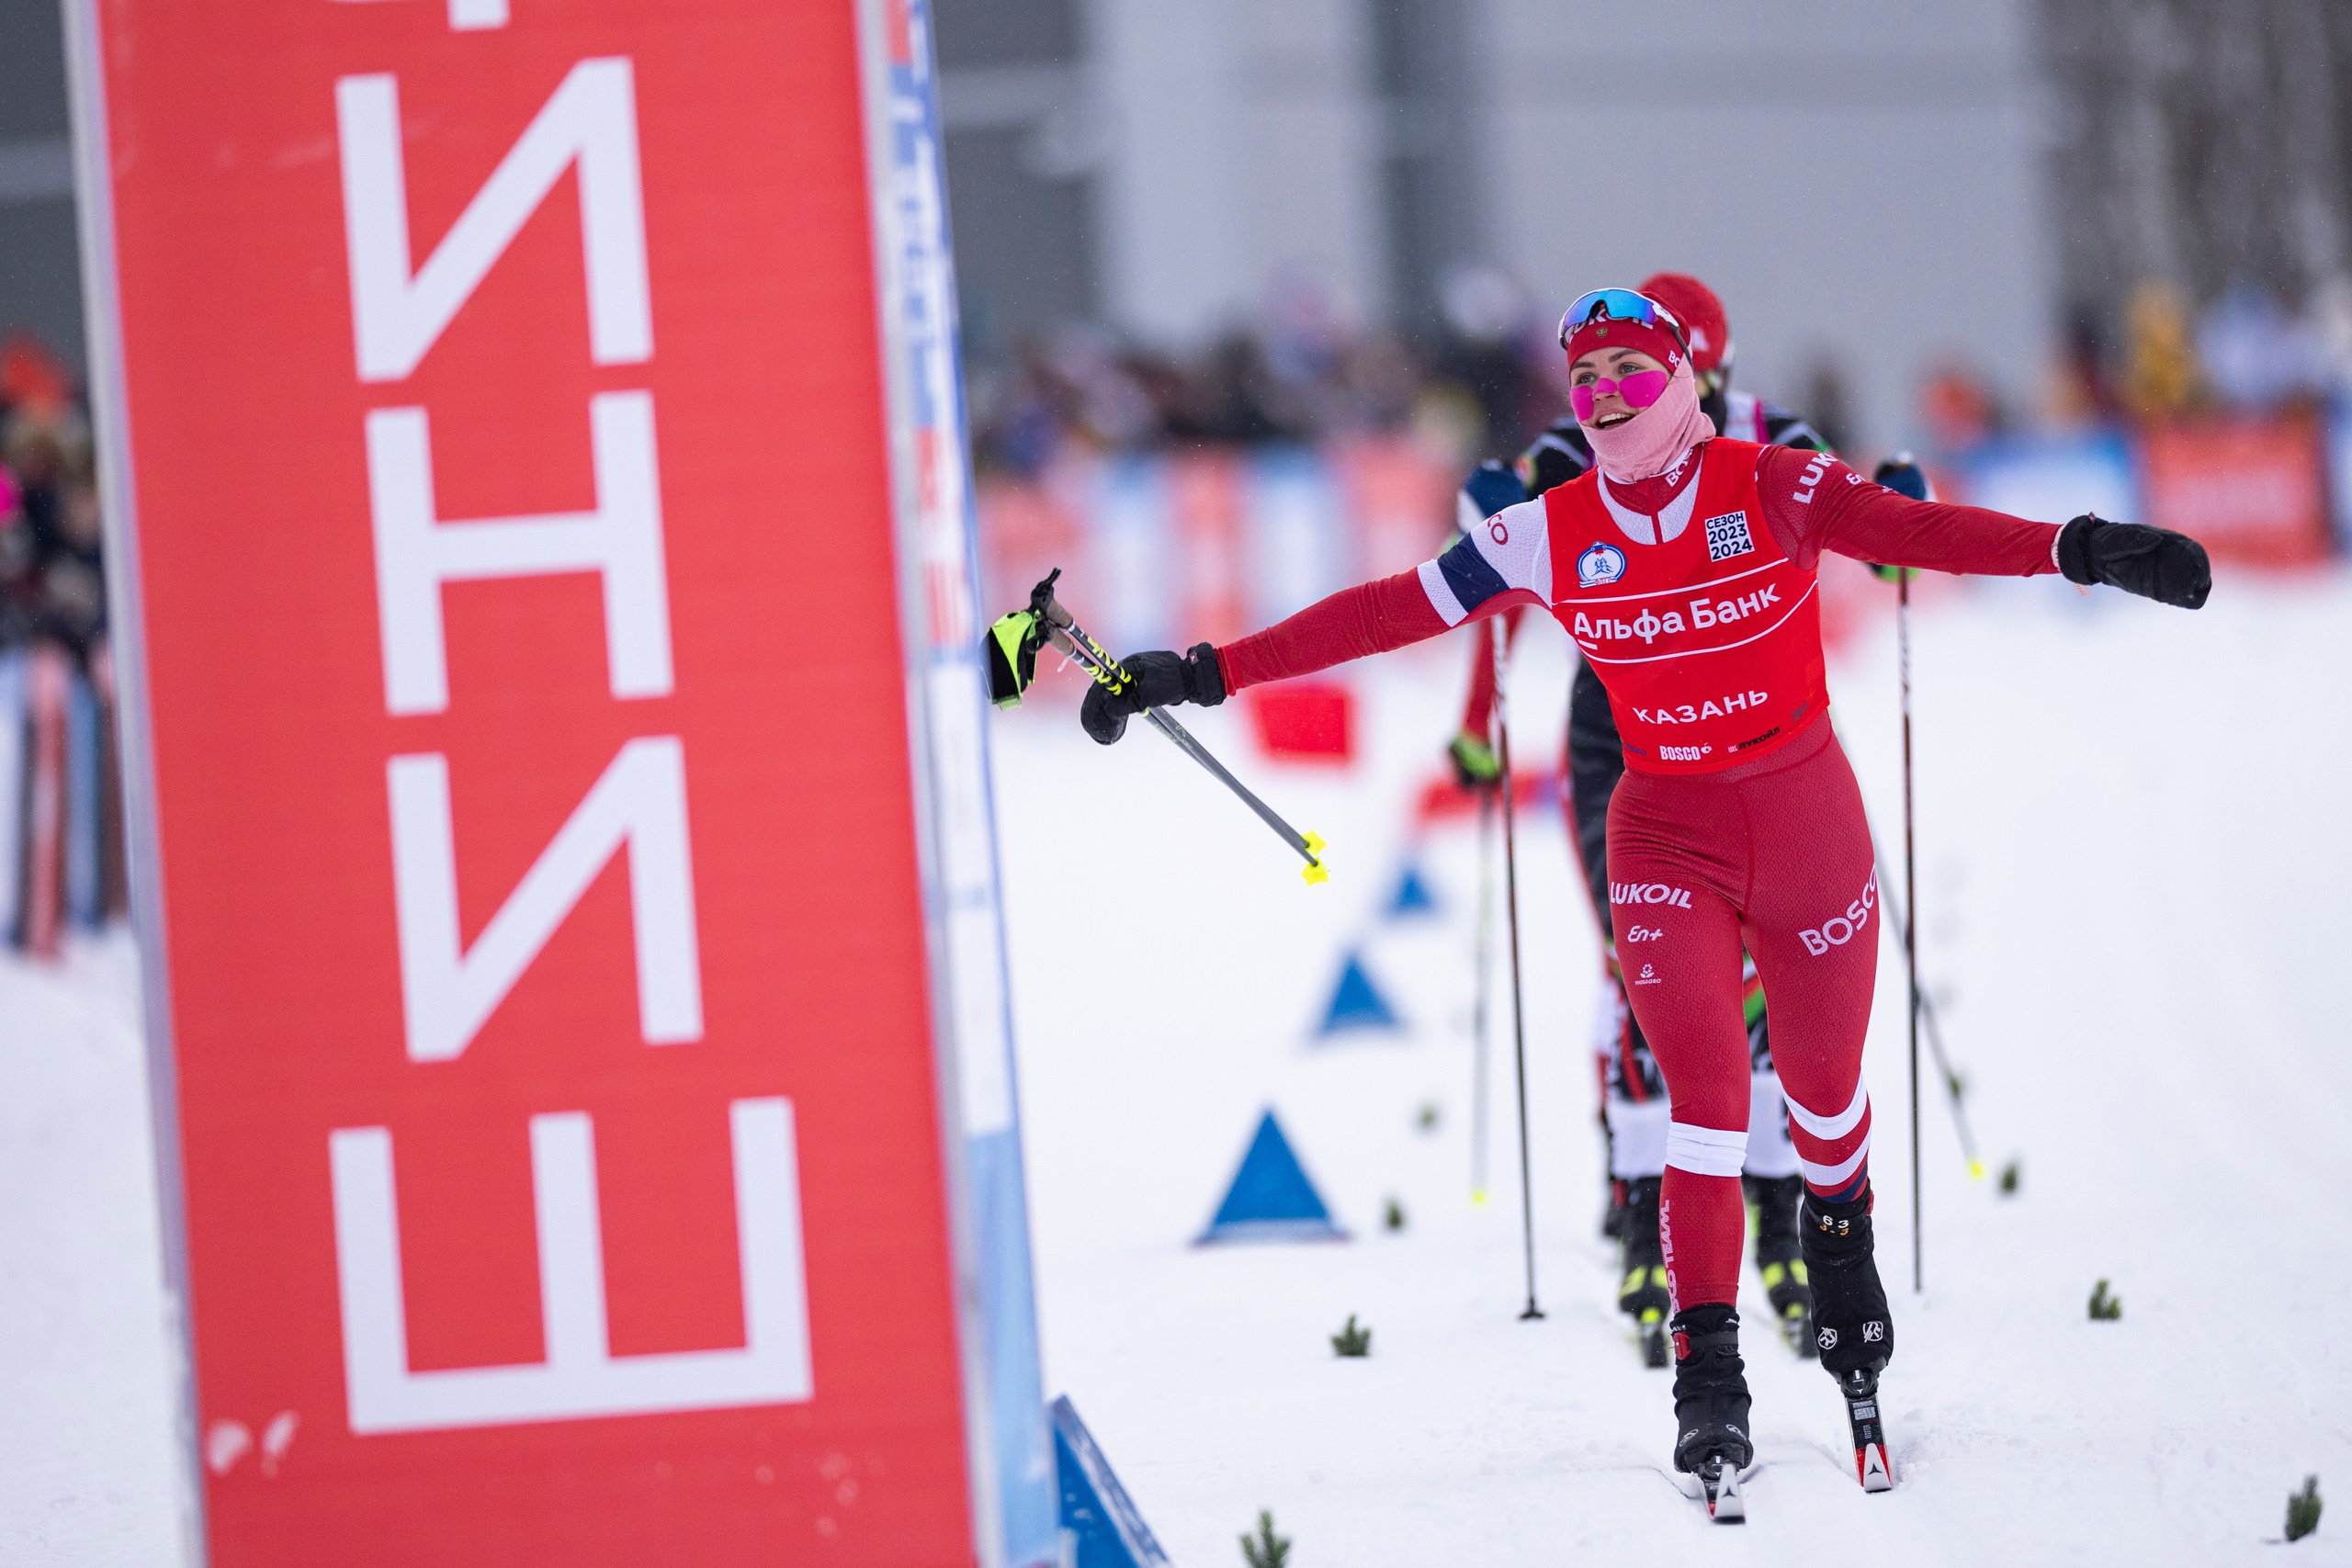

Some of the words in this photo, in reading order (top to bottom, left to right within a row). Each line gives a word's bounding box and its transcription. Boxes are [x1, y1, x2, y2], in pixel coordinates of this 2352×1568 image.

[1706, 512, 1744, 530] СЕЗОН
[1708, 523, 1747, 545] 2023
[1711, 537, 1753, 560] 2024
[1574, 611, 1686, 646] Альфа
[1689, 582, 1781, 630] Банк
[329, 0, 814, 1435] ИНИШ
[1632, 690, 1769, 725] КАЗАНЬ
[1738, 726, 1781, 750] ЛУКОЙЛ
[1659, 745, 1701, 761] BOSCO
[1610, 882, 1692, 909] LUKOIL
[1627, 925, 1664, 943] En+
[1659, 1199, 1674, 1269] TEAM
